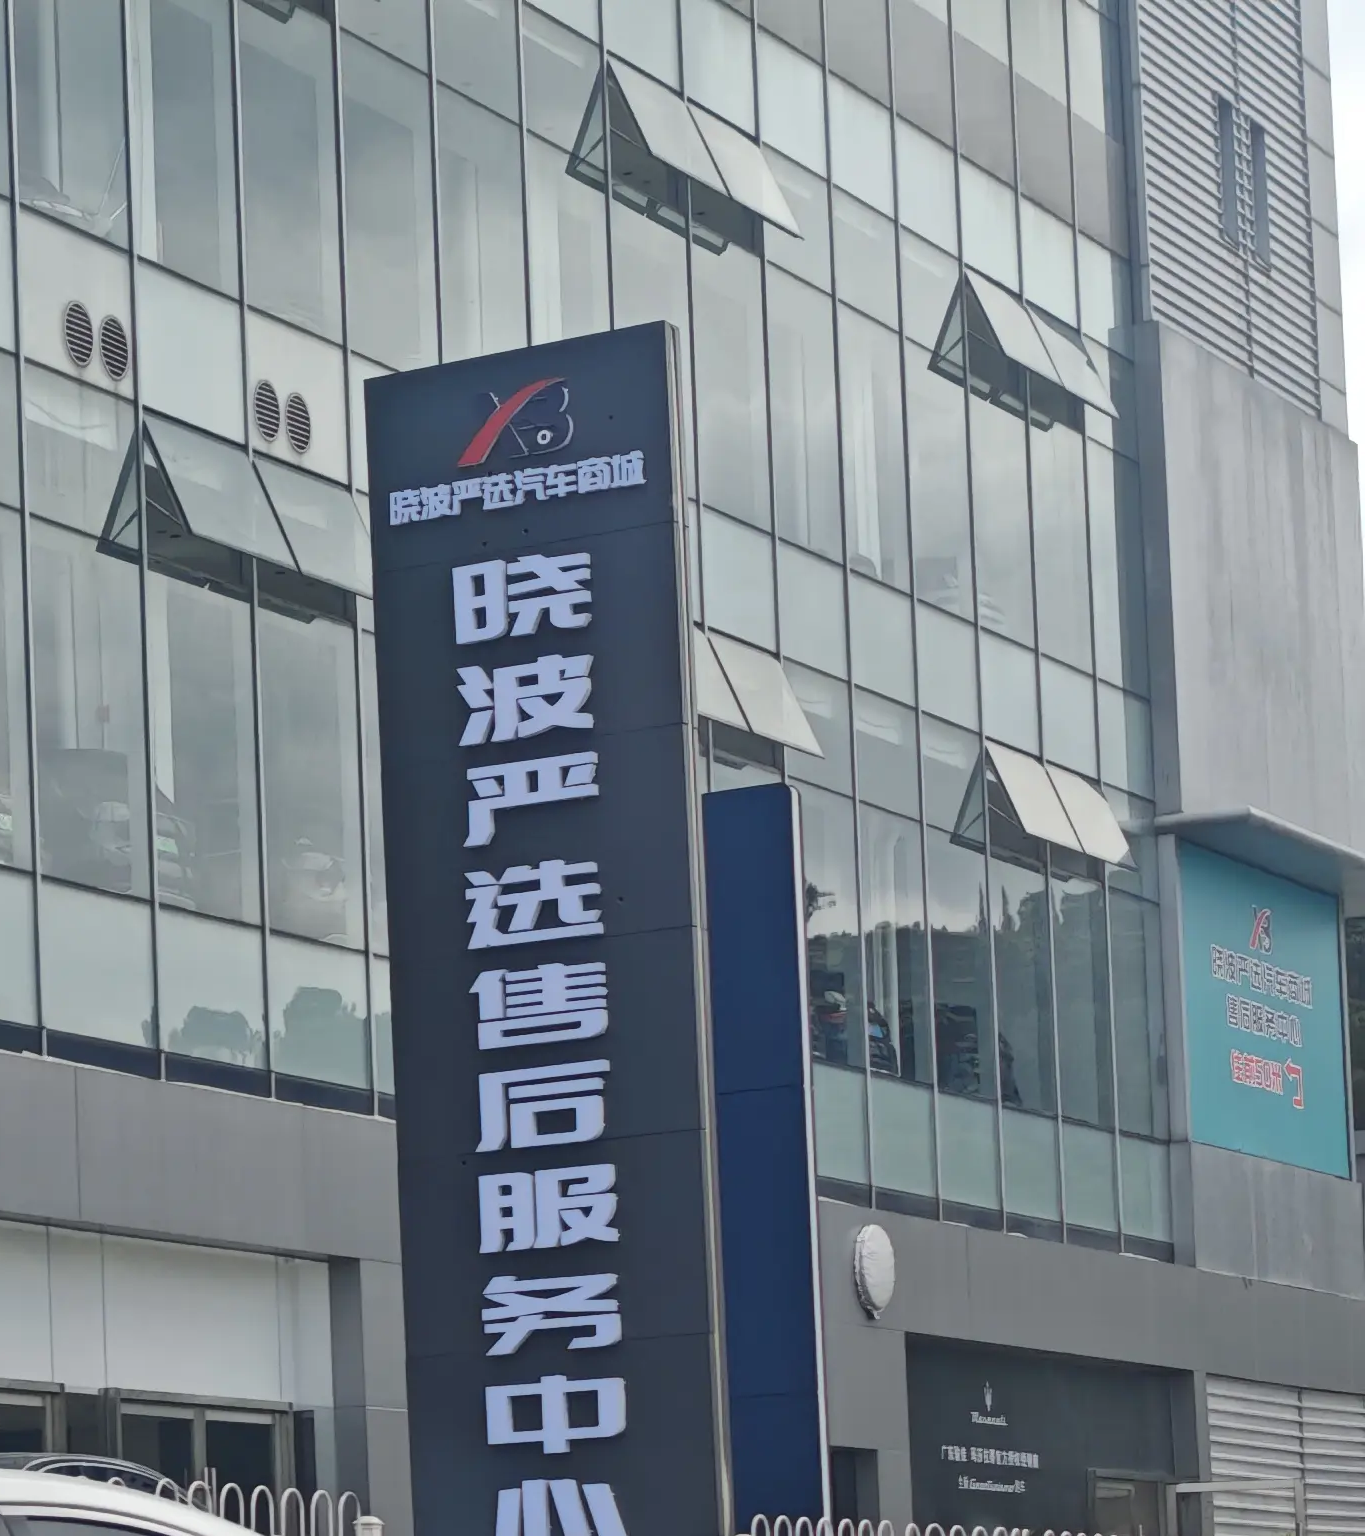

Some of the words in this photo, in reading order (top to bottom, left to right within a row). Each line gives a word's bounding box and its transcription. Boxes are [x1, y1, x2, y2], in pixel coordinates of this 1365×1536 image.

[389, 450, 648, 527] 晓波严选汽车商城
